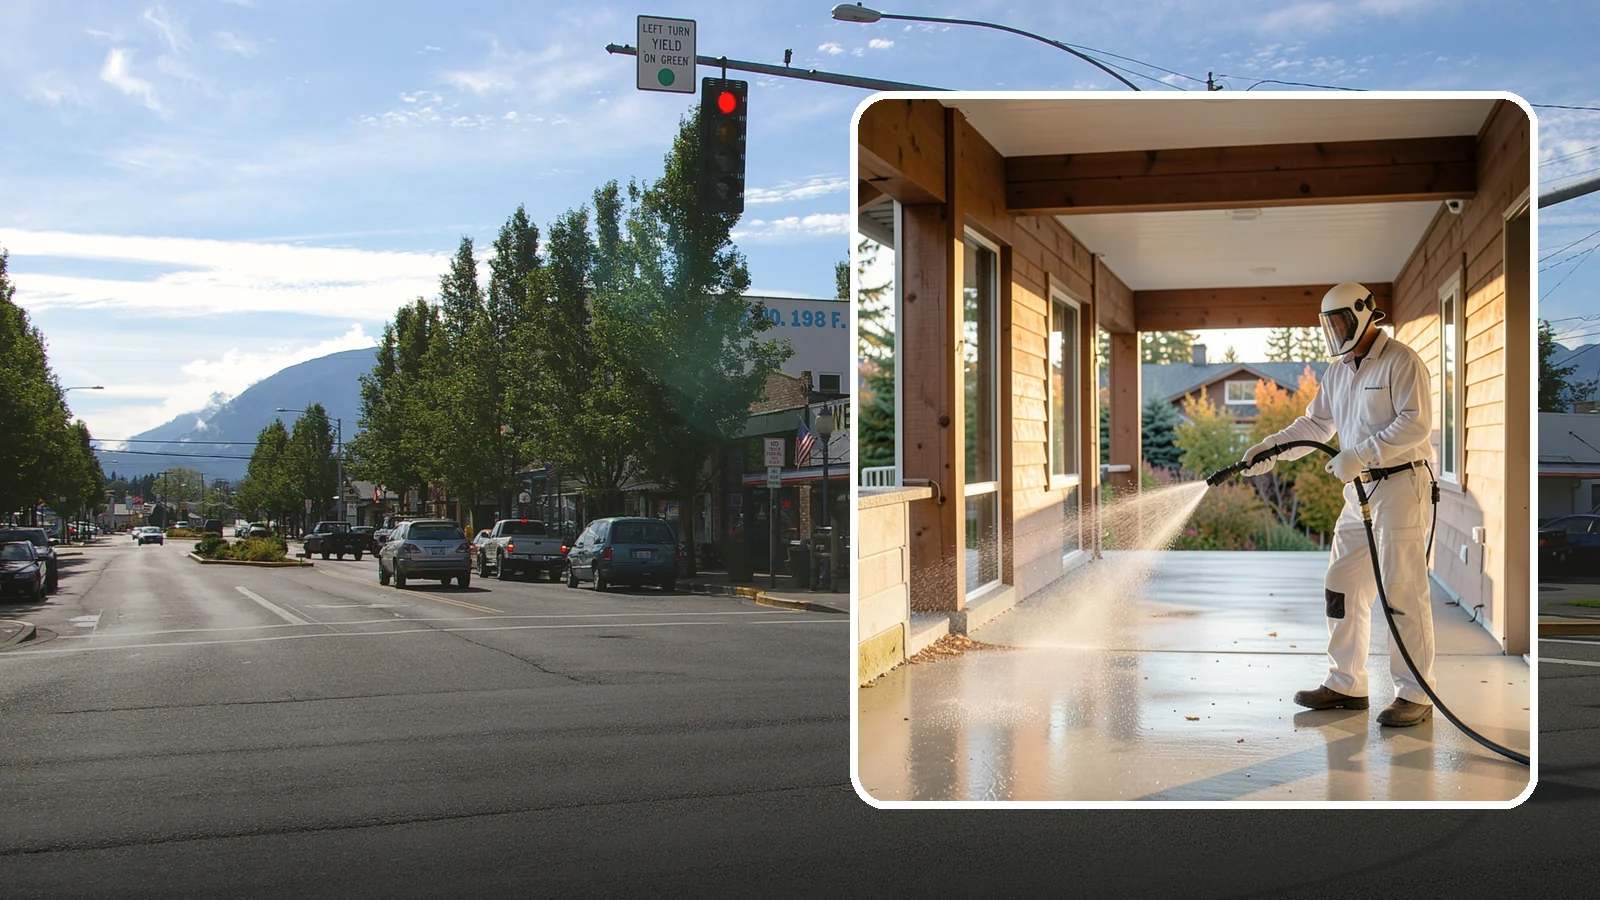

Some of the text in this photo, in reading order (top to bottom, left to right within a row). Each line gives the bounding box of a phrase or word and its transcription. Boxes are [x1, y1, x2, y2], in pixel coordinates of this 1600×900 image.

[643, 24, 689, 36] LEFT TURN
[652, 38, 681, 51] YIELD
[644, 53, 688, 65] ON GREEN
[791, 309, 826, 328] 198
[831, 311, 846, 329] F.
